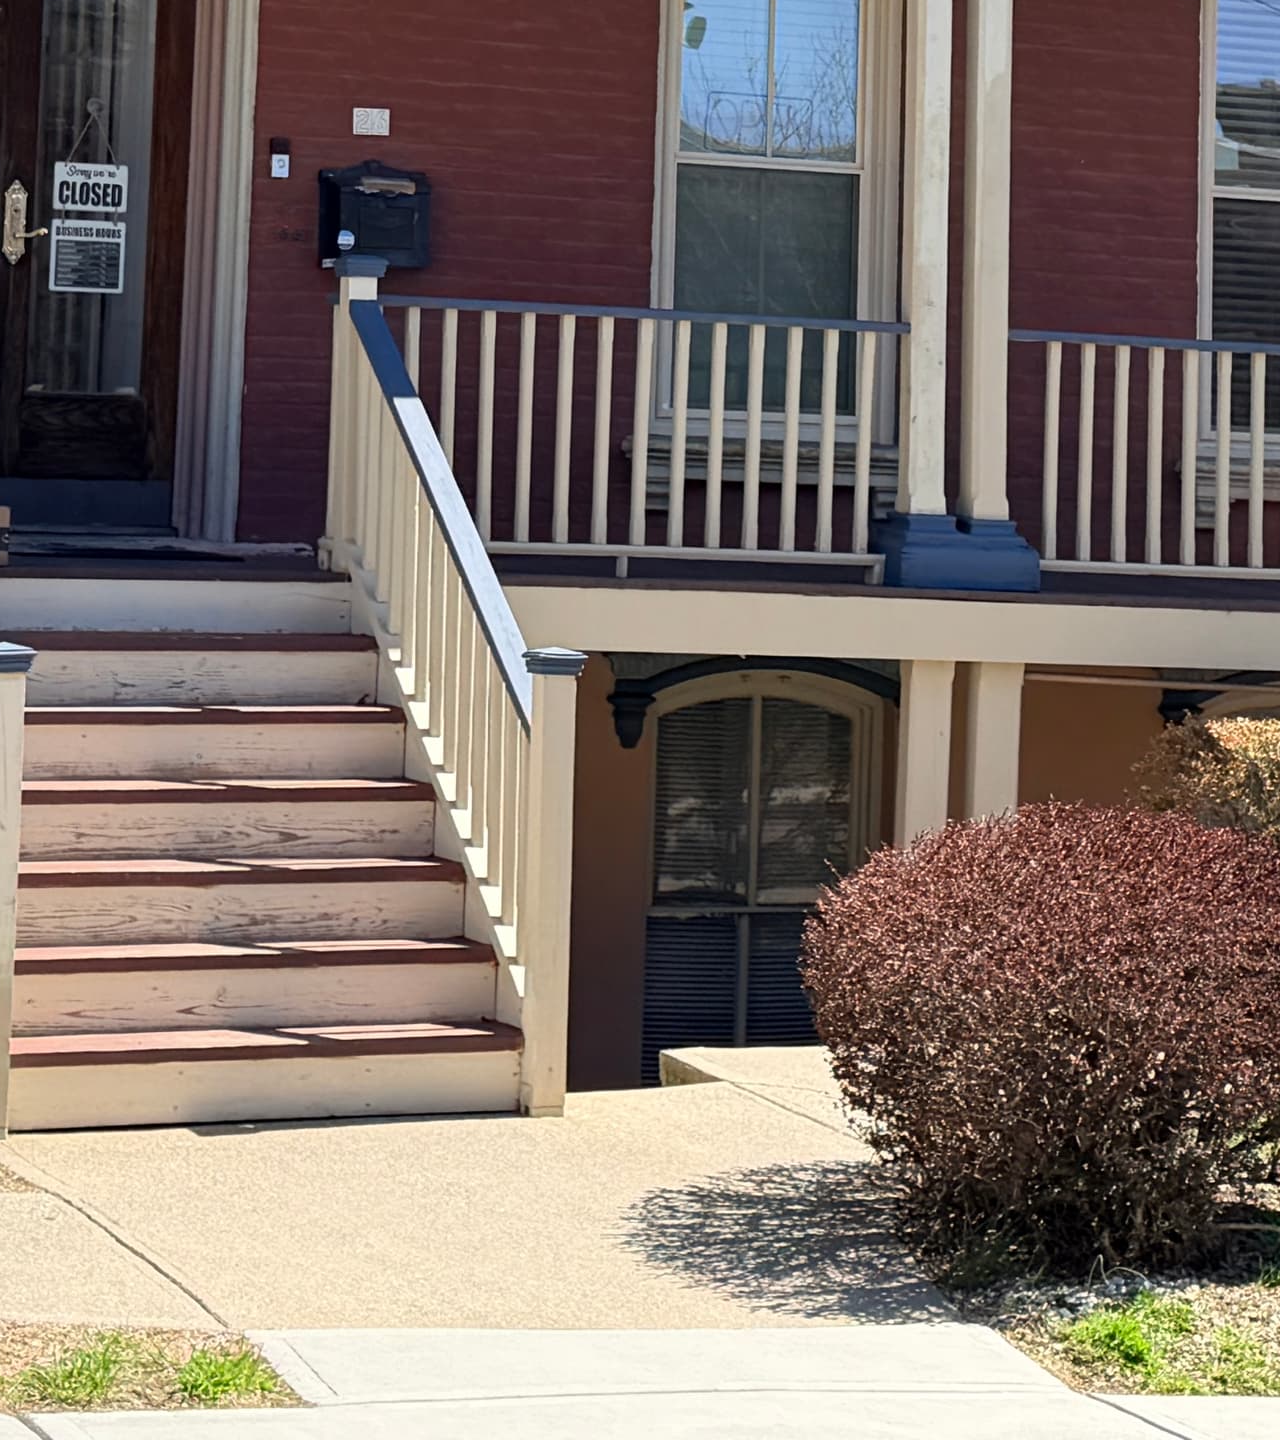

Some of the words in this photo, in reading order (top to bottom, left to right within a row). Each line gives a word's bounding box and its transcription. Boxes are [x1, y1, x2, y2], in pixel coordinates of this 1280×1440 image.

[58, 180, 123, 208] CLOSED
[55, 225, 94, 238] BUSINESS
[95, 227, 122, 240] HOURS
